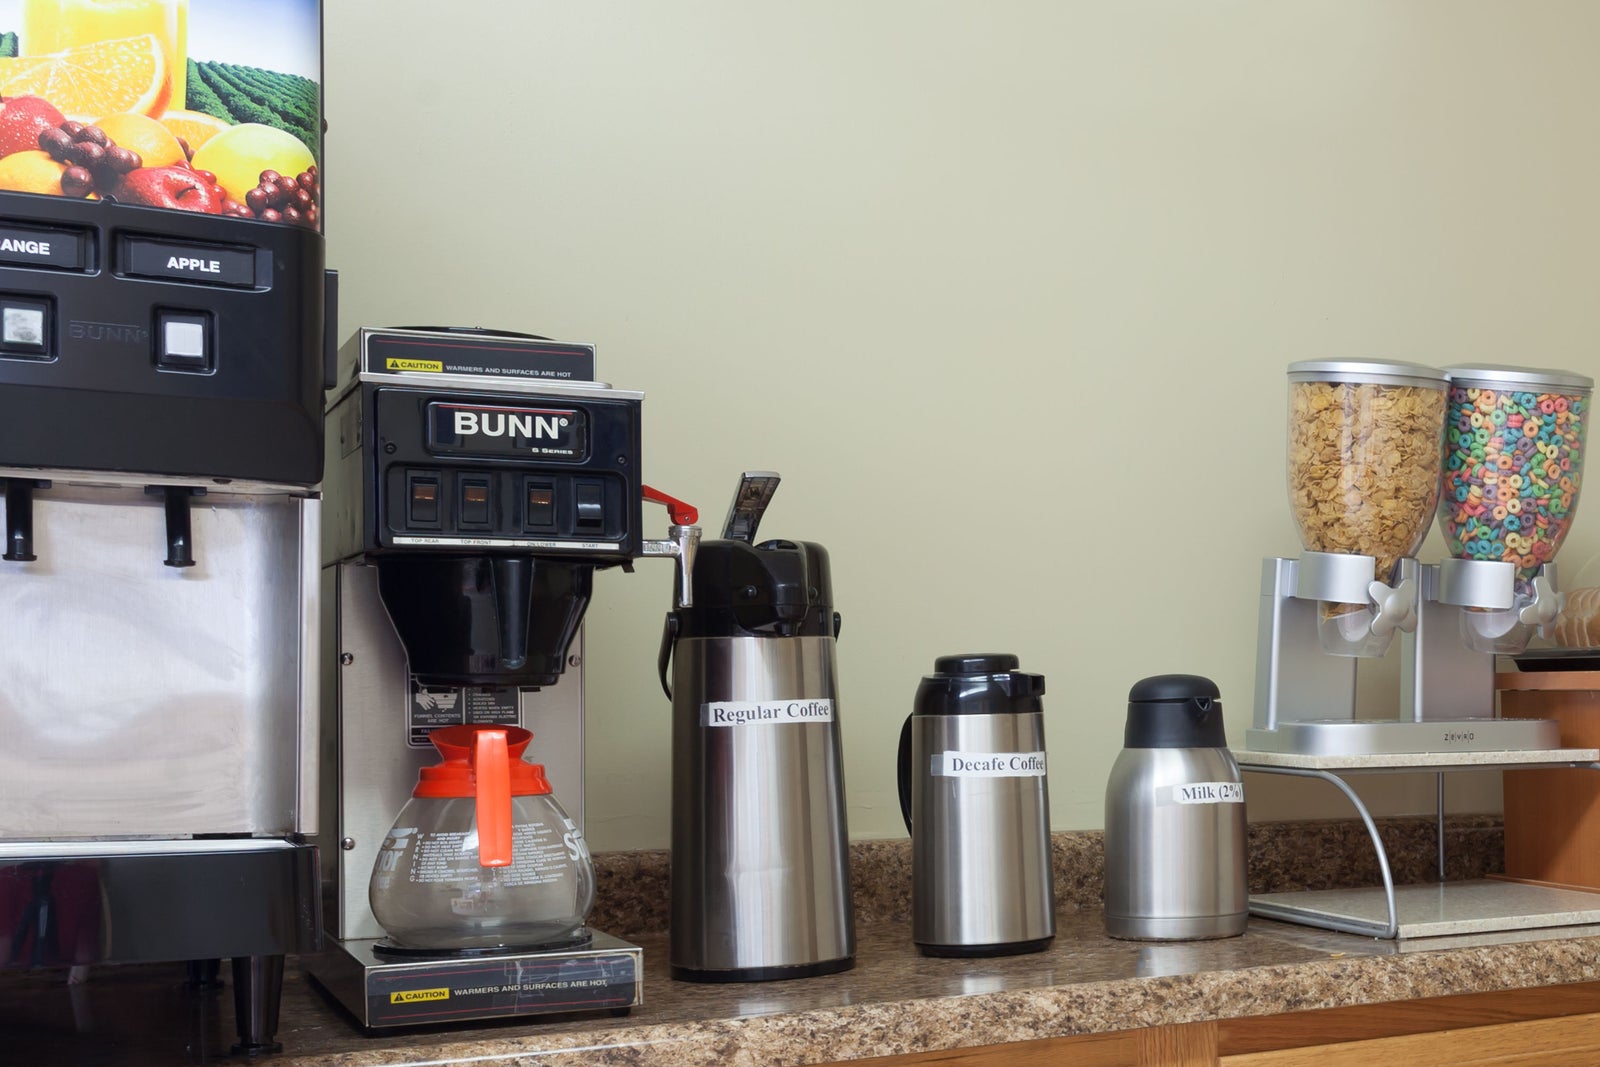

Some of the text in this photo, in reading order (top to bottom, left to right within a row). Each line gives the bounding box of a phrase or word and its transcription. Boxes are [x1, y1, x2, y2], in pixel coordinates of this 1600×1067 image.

[0, 238, 51, 256] ANGE
[166, 256, 221, 273] APPLE
[400, 361, 440, 370] CAUTION
[445, 365, 484, 373] WARMERS
[484, 366, 501, 374] AND
[501, 368, 540, 376] SURFACES
[713, 701, 829, 725] Regular Coffee
[951, 756, 1044, 772] Decafe Coffee
[1181, 784, 1242, 801] Milk (2%)
[405, 979, 608, 1001] CAUTION WARMERS AND SURFACES ARE HOT
